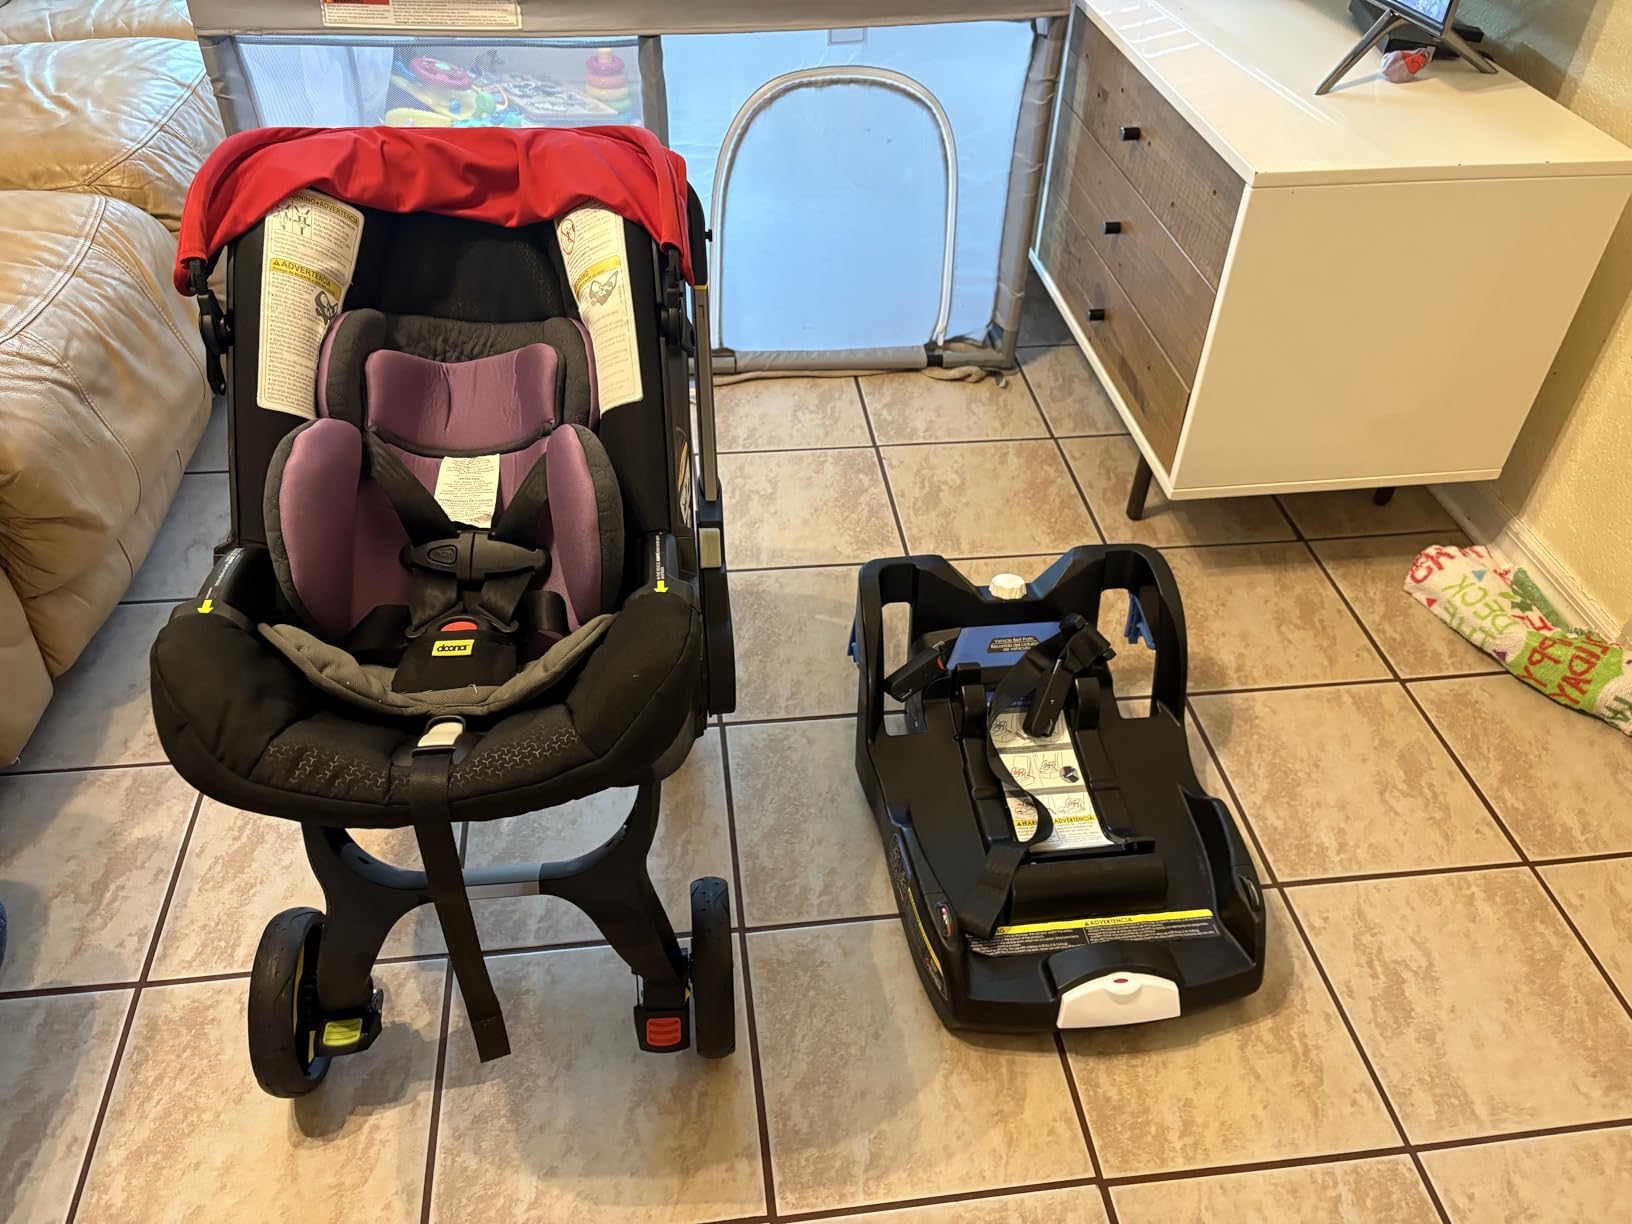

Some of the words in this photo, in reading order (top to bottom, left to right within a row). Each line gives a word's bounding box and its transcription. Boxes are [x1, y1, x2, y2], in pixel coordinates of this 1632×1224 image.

[287, 193, 316, 205] ARNING
[281, 261, 331, 287] ADVERTENCIA
[437, 644, 467, 652] doona
[1090, 917, 1133, 926] ADVERTENCIA
